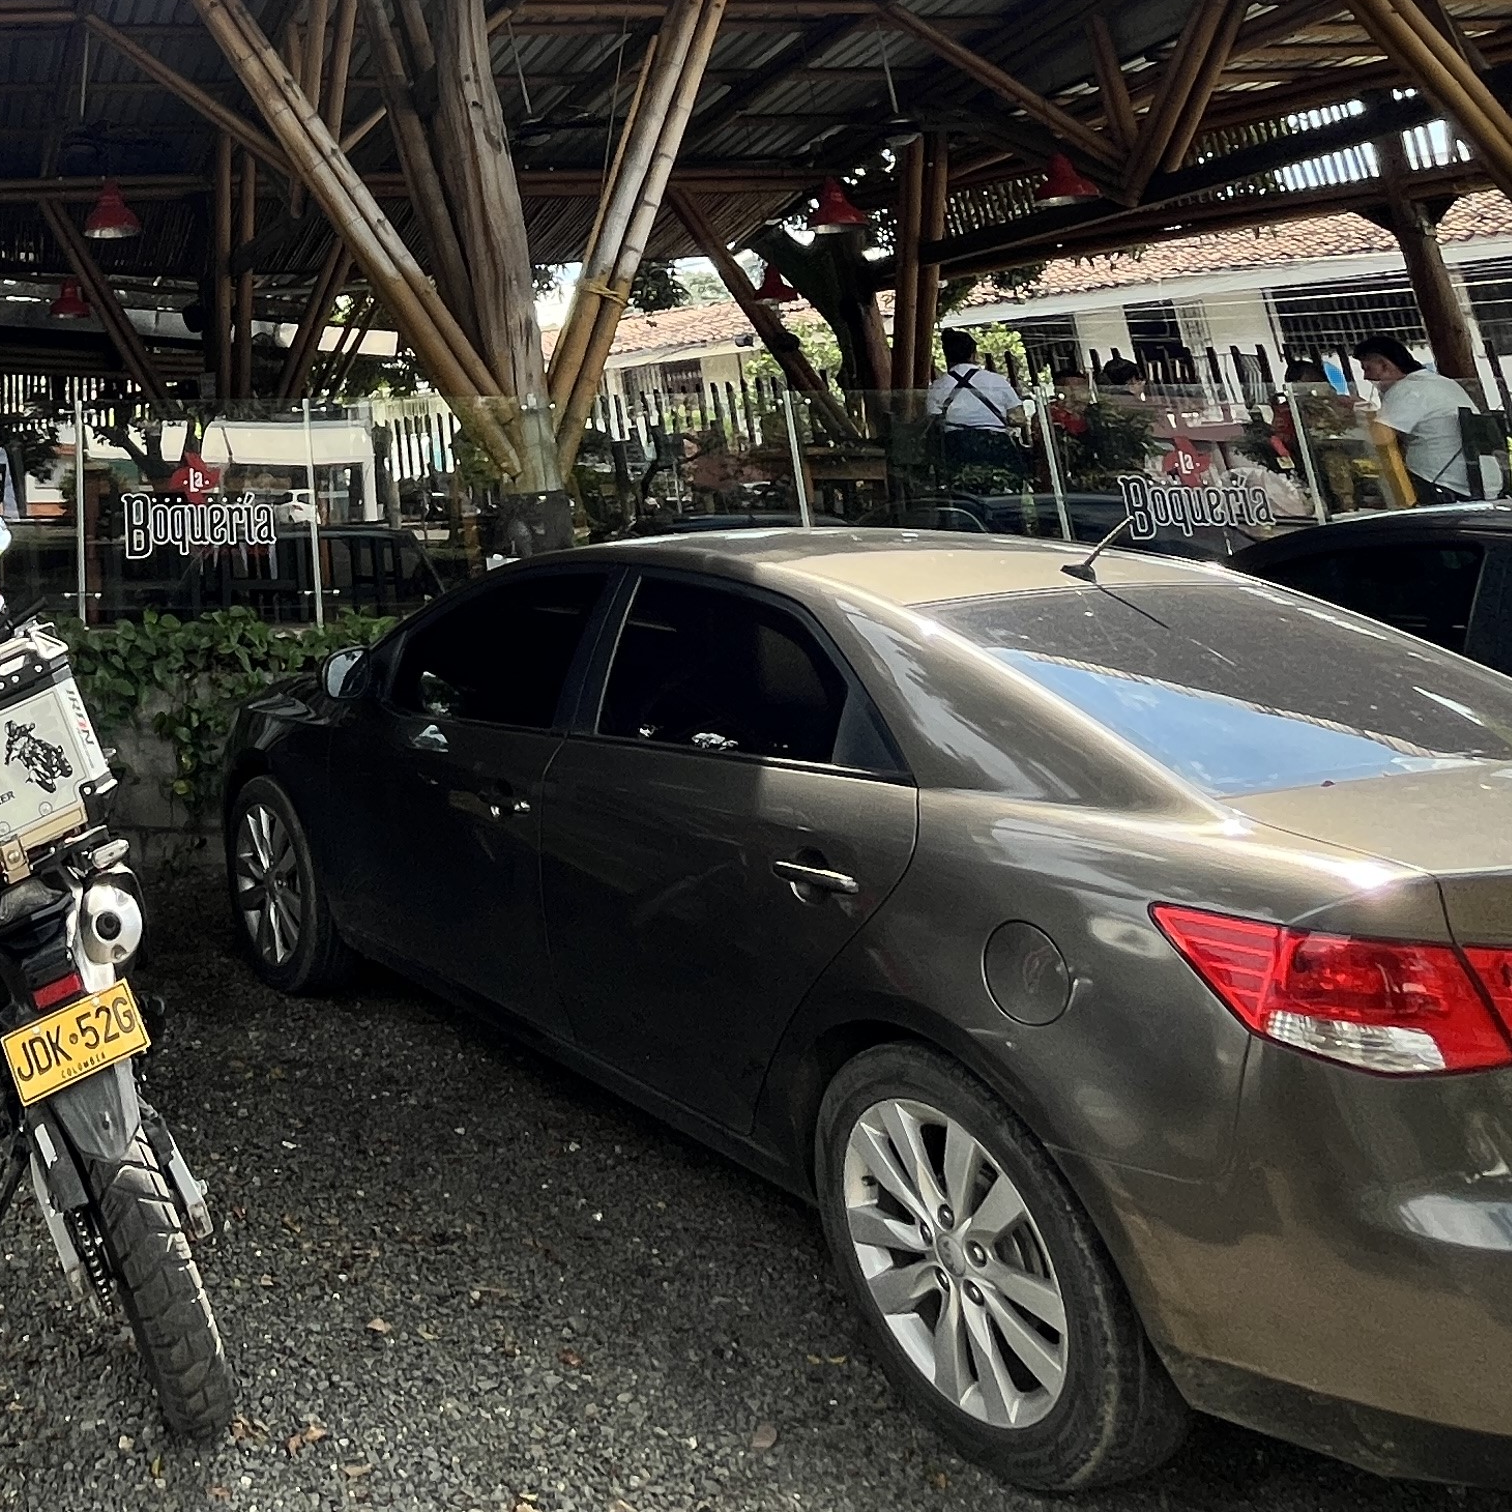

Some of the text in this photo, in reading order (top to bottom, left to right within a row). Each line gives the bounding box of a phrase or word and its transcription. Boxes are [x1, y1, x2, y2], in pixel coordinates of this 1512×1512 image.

[1178, 450, 1194, 475] La
[189, 468, 204, 493] La
[1117, 474, 1277, 540] Boquería
[121, 492, 277, 560] Boquería
[61, 1051, 106, 1079] COLOMBIA
